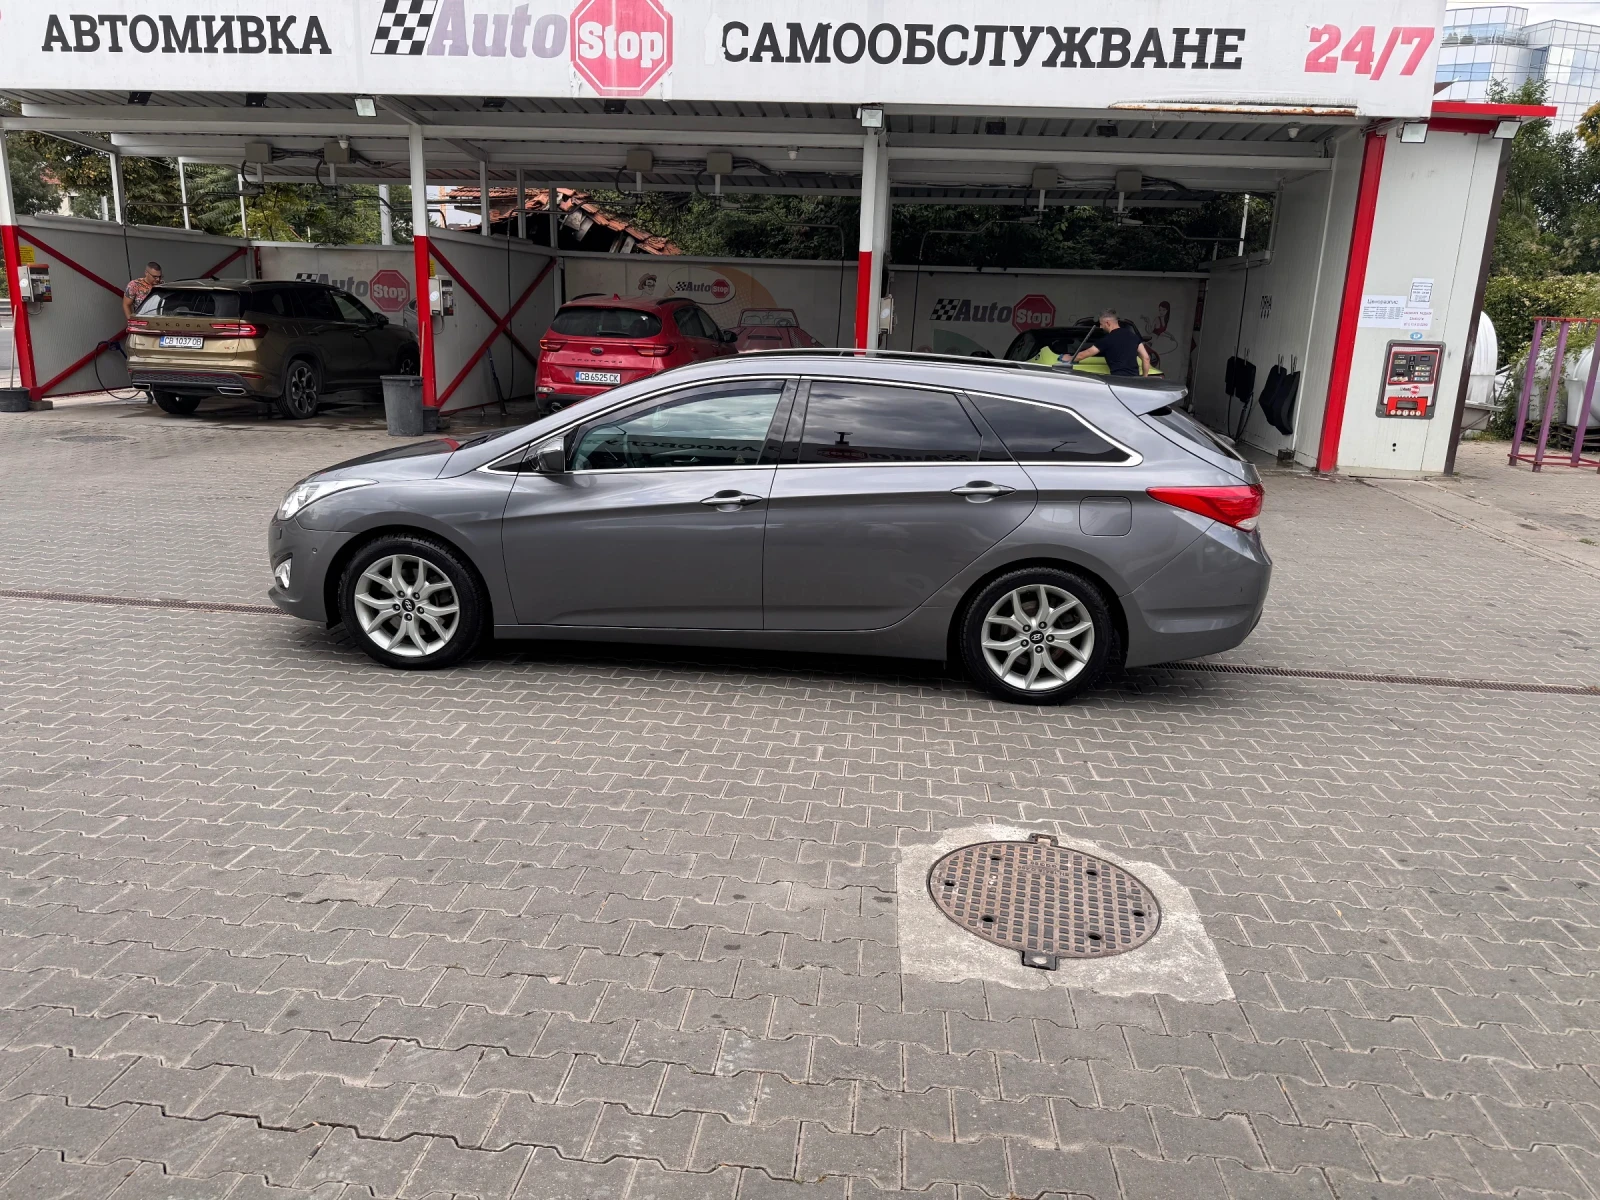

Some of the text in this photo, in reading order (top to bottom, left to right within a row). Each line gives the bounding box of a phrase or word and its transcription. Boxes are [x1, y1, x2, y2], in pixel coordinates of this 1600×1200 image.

[42, 14, 332, 54] АВТОМИВКА
[427, 0, 663, 68] Auto Stop
[722, 21, 1246, 69] САМООБСЛУЖВАНЕ
[1304, 24, 1435, 80] 24/7
[373, 284, 407, 301] Stop
[686, 282, 728, 294] Auto Stop
[954, 300, 1051, 326] Auto Stop
[164, 336, 174, 345] CB
[175, 337, 190, 345] 1037
[580, 373, 590, 381] CB
[591, 374, 608, 382] 6525
